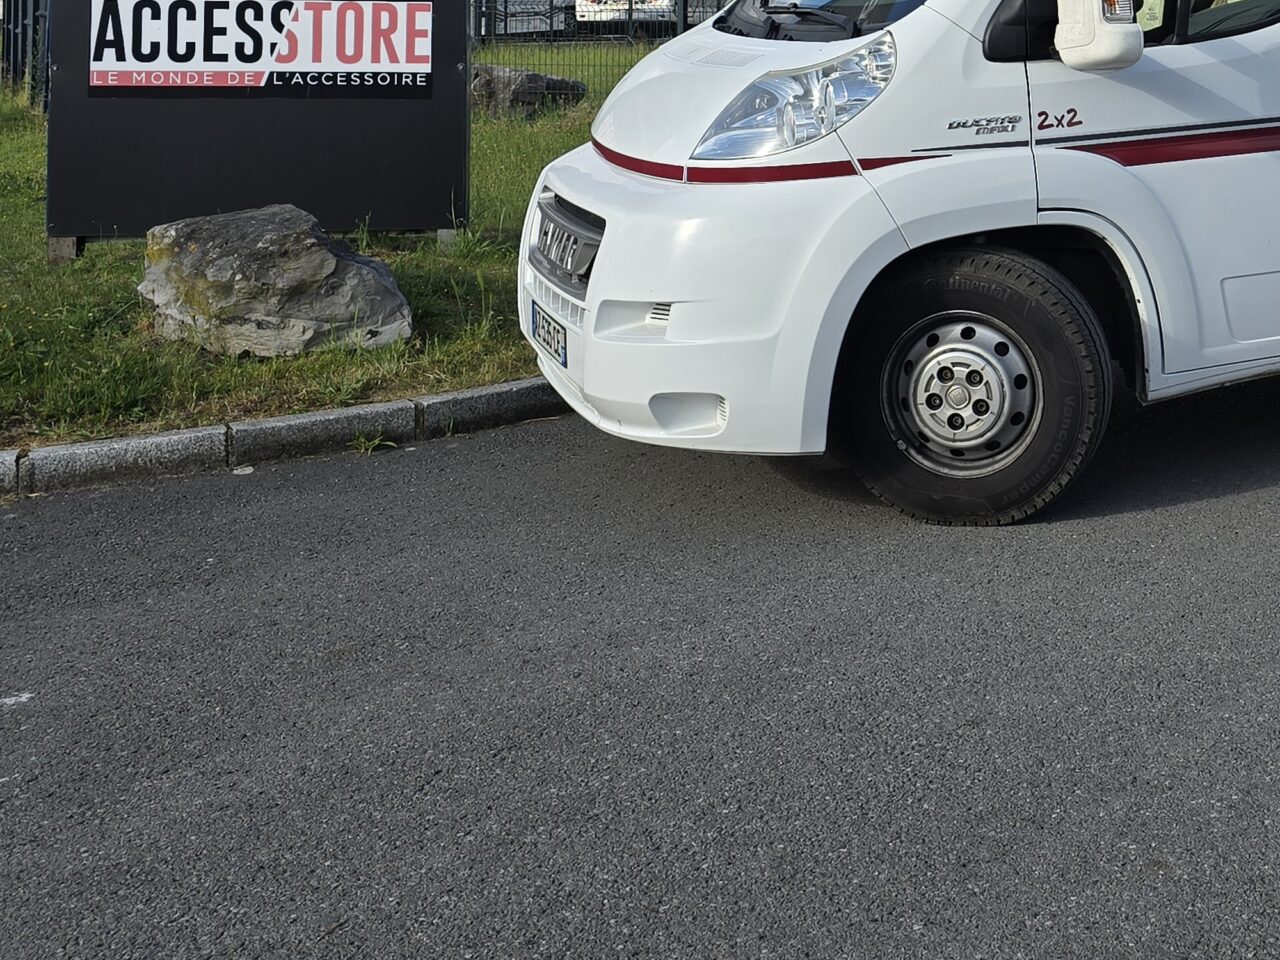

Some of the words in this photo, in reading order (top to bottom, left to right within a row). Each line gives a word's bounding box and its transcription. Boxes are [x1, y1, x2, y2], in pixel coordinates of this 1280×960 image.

[92, 0, 431, 65] ACCESSTORE
[93, 71, 118, 85] LE
[133, 71, 214, 85] MONDE
[228, 71, 255, 85] DE
[273, 72, 427, 86] L'ACCESSOIRE
[1037, 108, 1083, 131] 2x2
